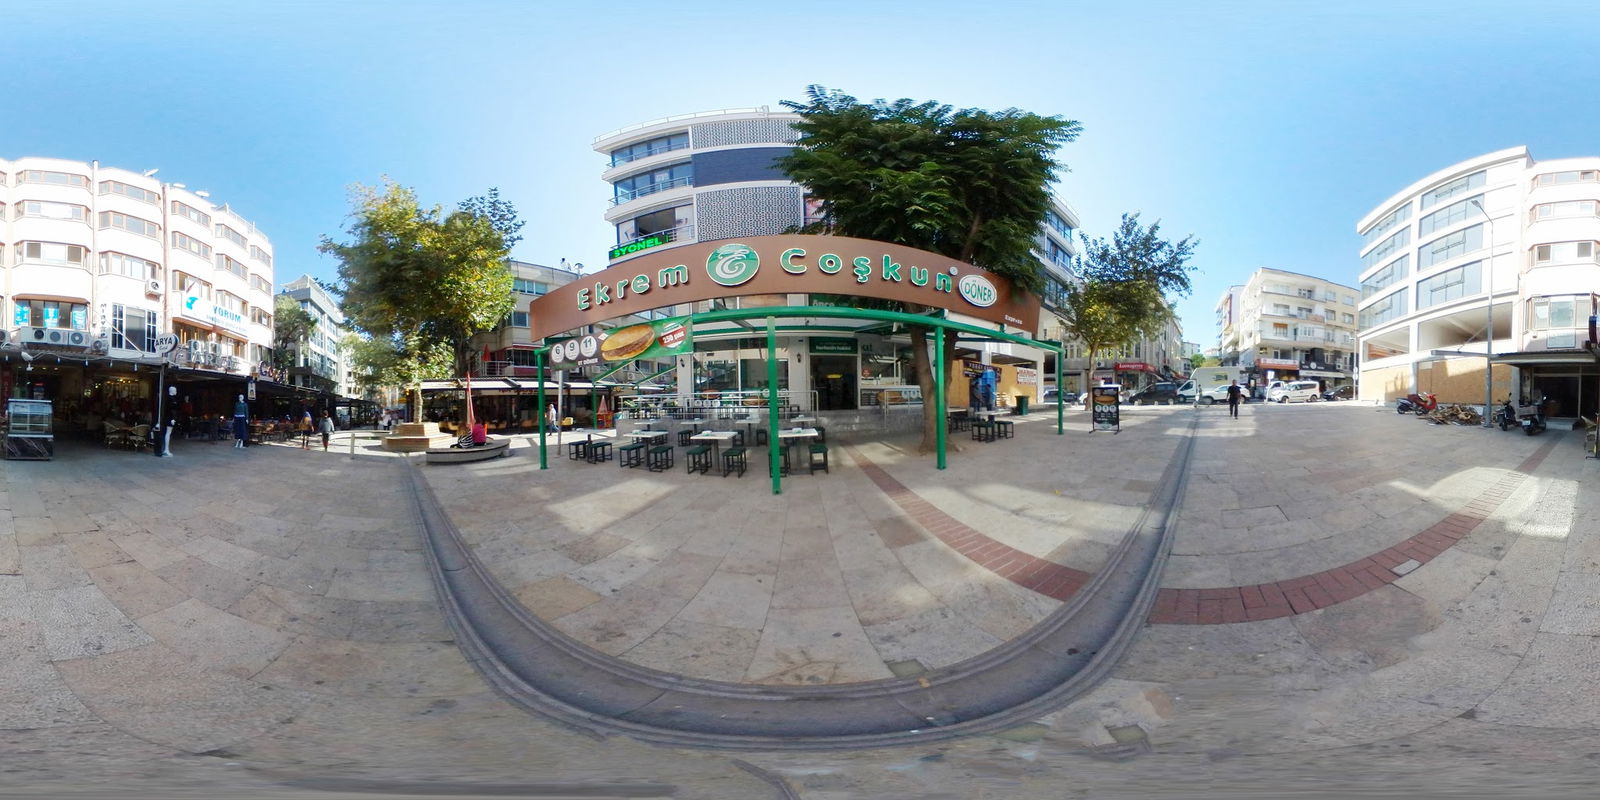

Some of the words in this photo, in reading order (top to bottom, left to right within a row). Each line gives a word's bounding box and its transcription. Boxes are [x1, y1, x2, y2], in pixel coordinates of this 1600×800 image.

[779, 247, 952, 293] Coşkun
[576, 264, 689, 311] Ekrem
[964, 279, 992, 301] DÖNER
[155, 336, 173, 346] ARYA
[555, 345, 561, 355] 6
[569, 342, 575, 351] 9
[583, 338, 592, 348] 11
